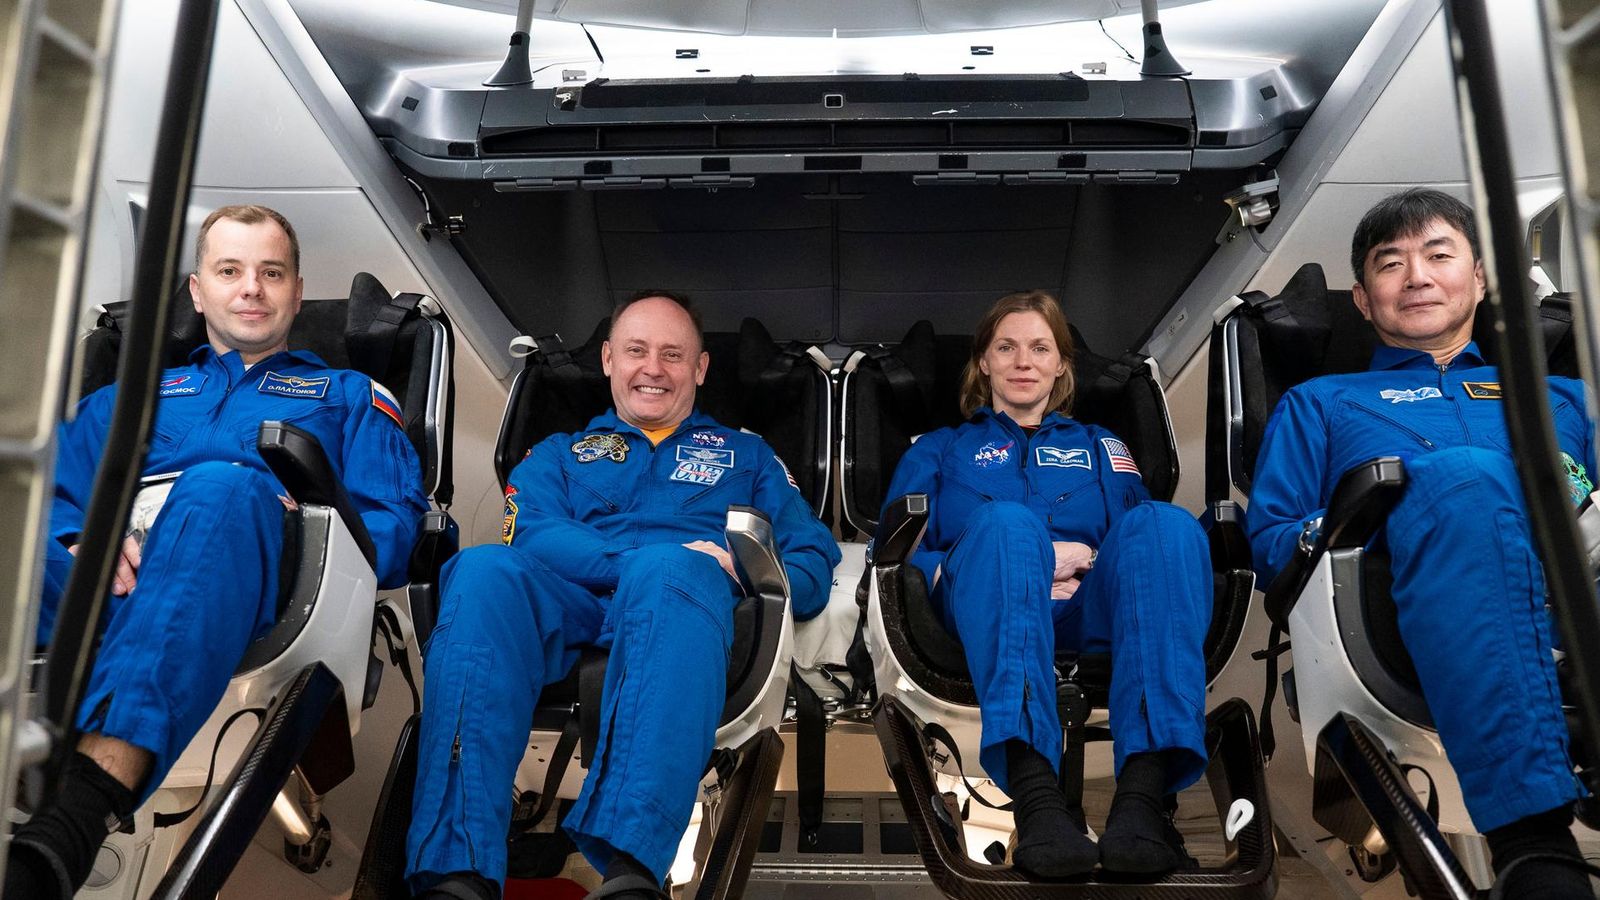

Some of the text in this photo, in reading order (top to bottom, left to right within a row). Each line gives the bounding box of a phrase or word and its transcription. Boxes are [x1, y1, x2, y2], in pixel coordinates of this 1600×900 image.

[692, 433, 725, 444] NASA
[975, 449, 1009, 461] NASA
[675, 462, 723, 483] ONE
